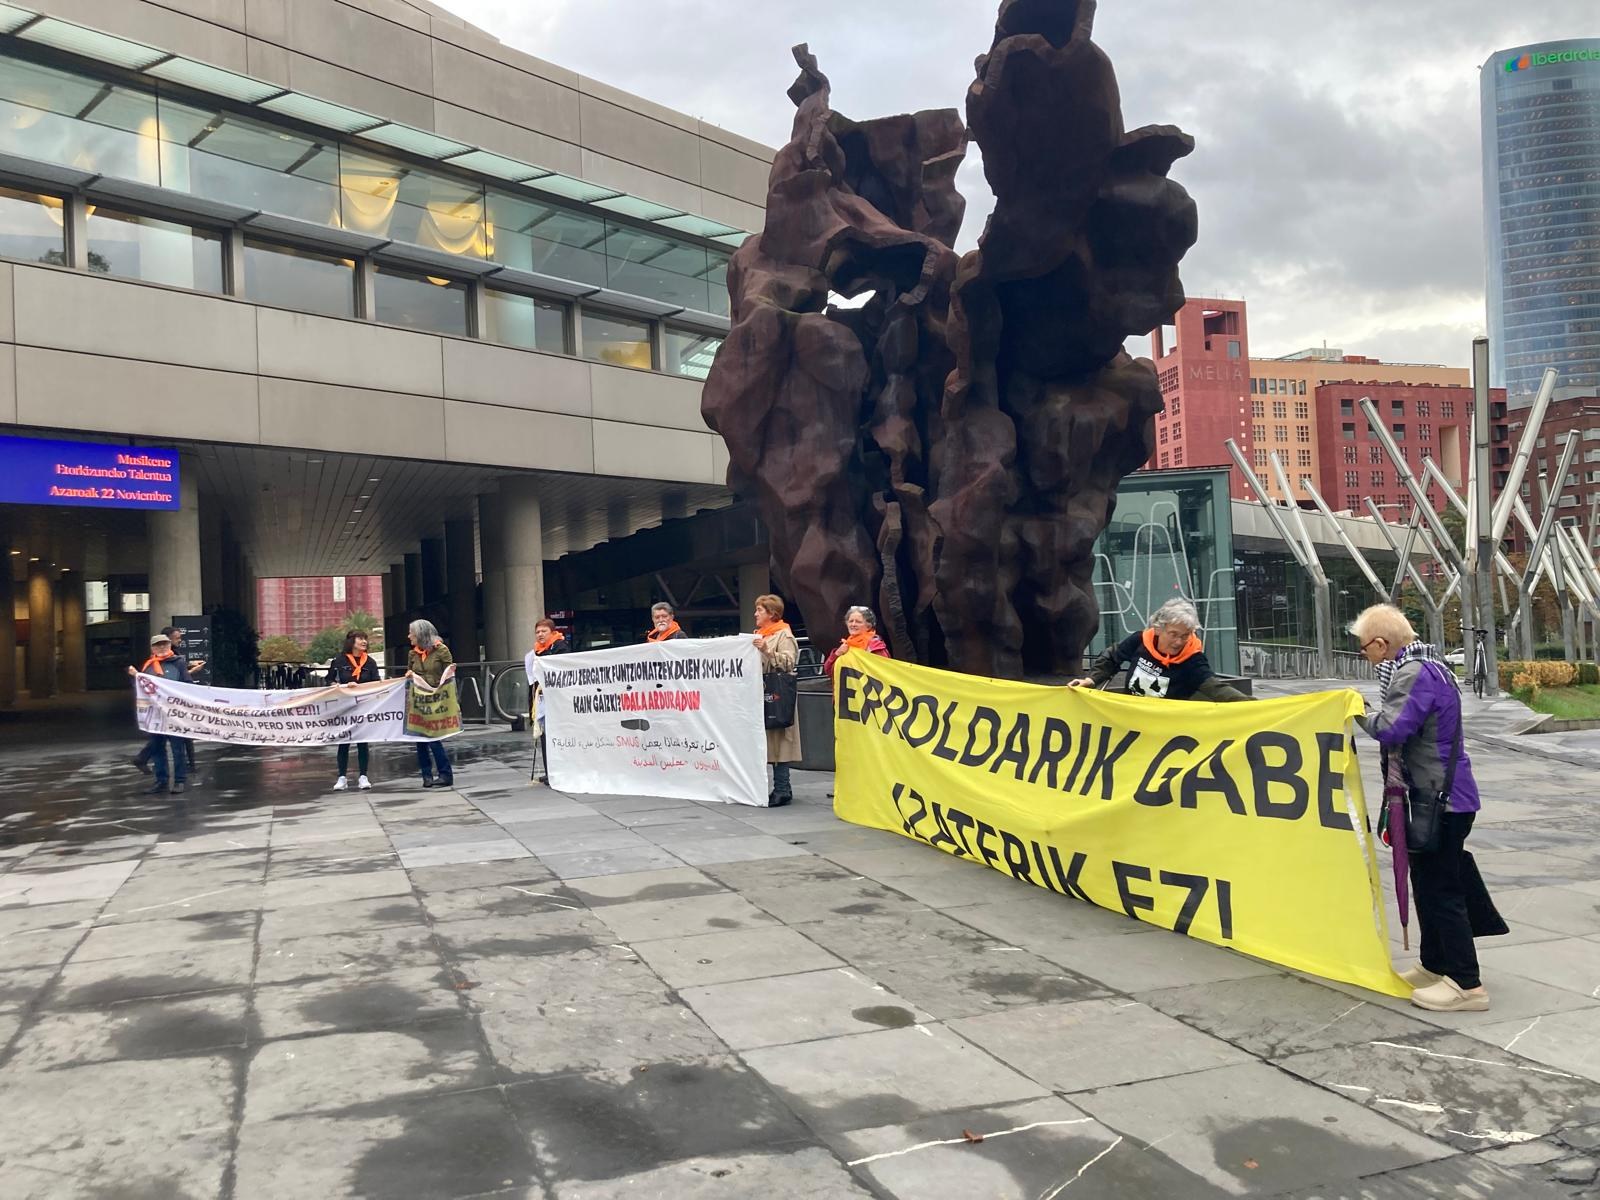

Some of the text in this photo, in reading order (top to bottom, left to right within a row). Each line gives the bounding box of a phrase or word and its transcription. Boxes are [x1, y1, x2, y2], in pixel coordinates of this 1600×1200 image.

[1531, 48, 1600, 66] Iberdrola
[117, 454, 172, 468] Musikene
[55, 464, 172, 482] Etorkizuneko Talentua
[50, 485, 172, 502] Azaroak 22 Noviembre
[578, 666, 612, 685] ZERGATIK
[675, 658, 700, 680] DUEN
[702, 658, 743, 679] SMUS-AK
[573, 694, 592, 713] HAIN
[593, 692, 621, 713] GAIZKI?
[621, 690, 647, 712] UDALA
[190, 712, 205, 722] TU
[258, 721, 284, 730] PERO
[286, 721, 304, 730] SIN
[350, 715, 365, 725] NO
[367, 711, 404, 723] EXISTO
[616, 735, 640, 748] SMUS
[839, 666, 1355, 832] ERROLDARIK GABE
